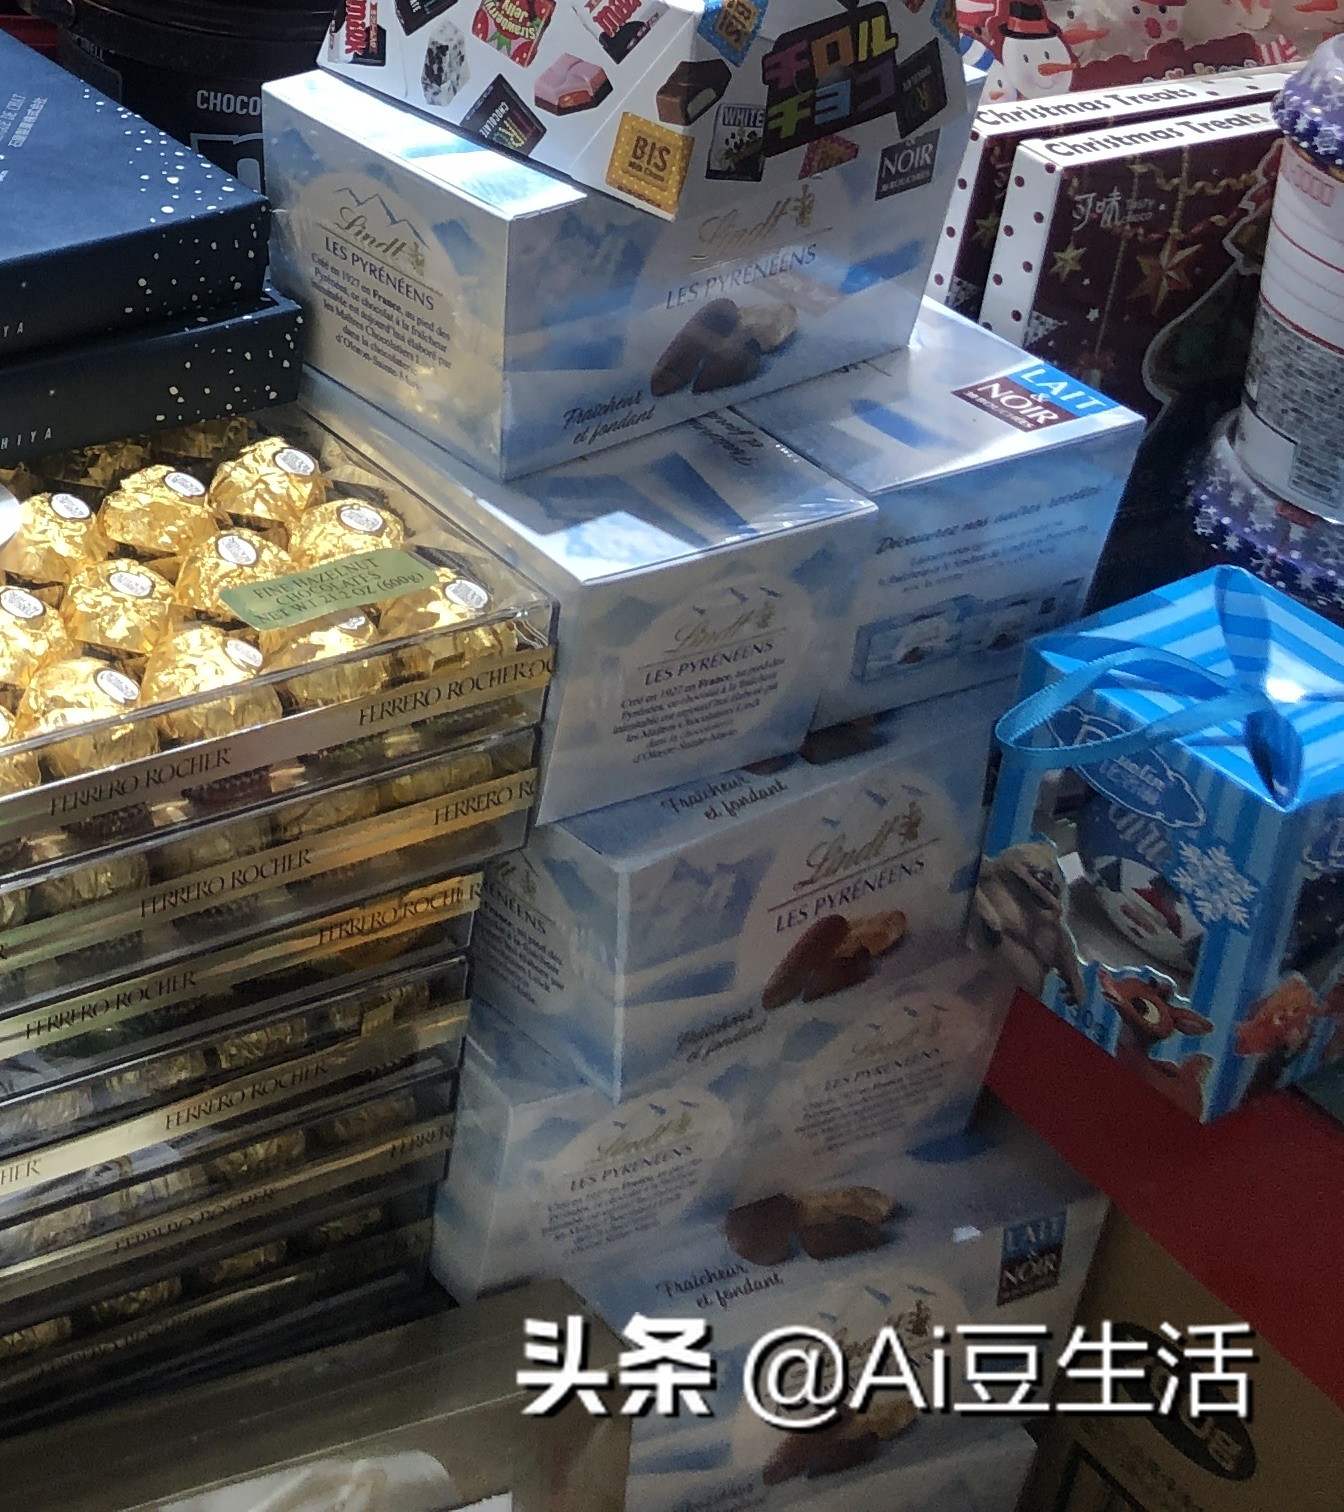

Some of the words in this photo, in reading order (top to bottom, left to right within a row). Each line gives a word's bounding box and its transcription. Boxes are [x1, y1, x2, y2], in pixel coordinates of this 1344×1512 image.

[976, 98, 1110, 128] Christmas
[1110, 83, 1195, 117] Treats
[631, 134, 671, 168] BIS
[1044, 125, 1176, 160] Christmas
[1176, 109, 1270, 143] Treats
[881, 143, 934, 179] NOIR
[324, 236, 348, 262] LES
[975, 379, 1057, 427] NOIR
[1023, 363, 1108, 413] LAIT
[273, 570, 382, 611] CHOCOLATES
[292, 556, 381, 590] HAZELNUT
[714, 1270, 783, 1308] fondant
